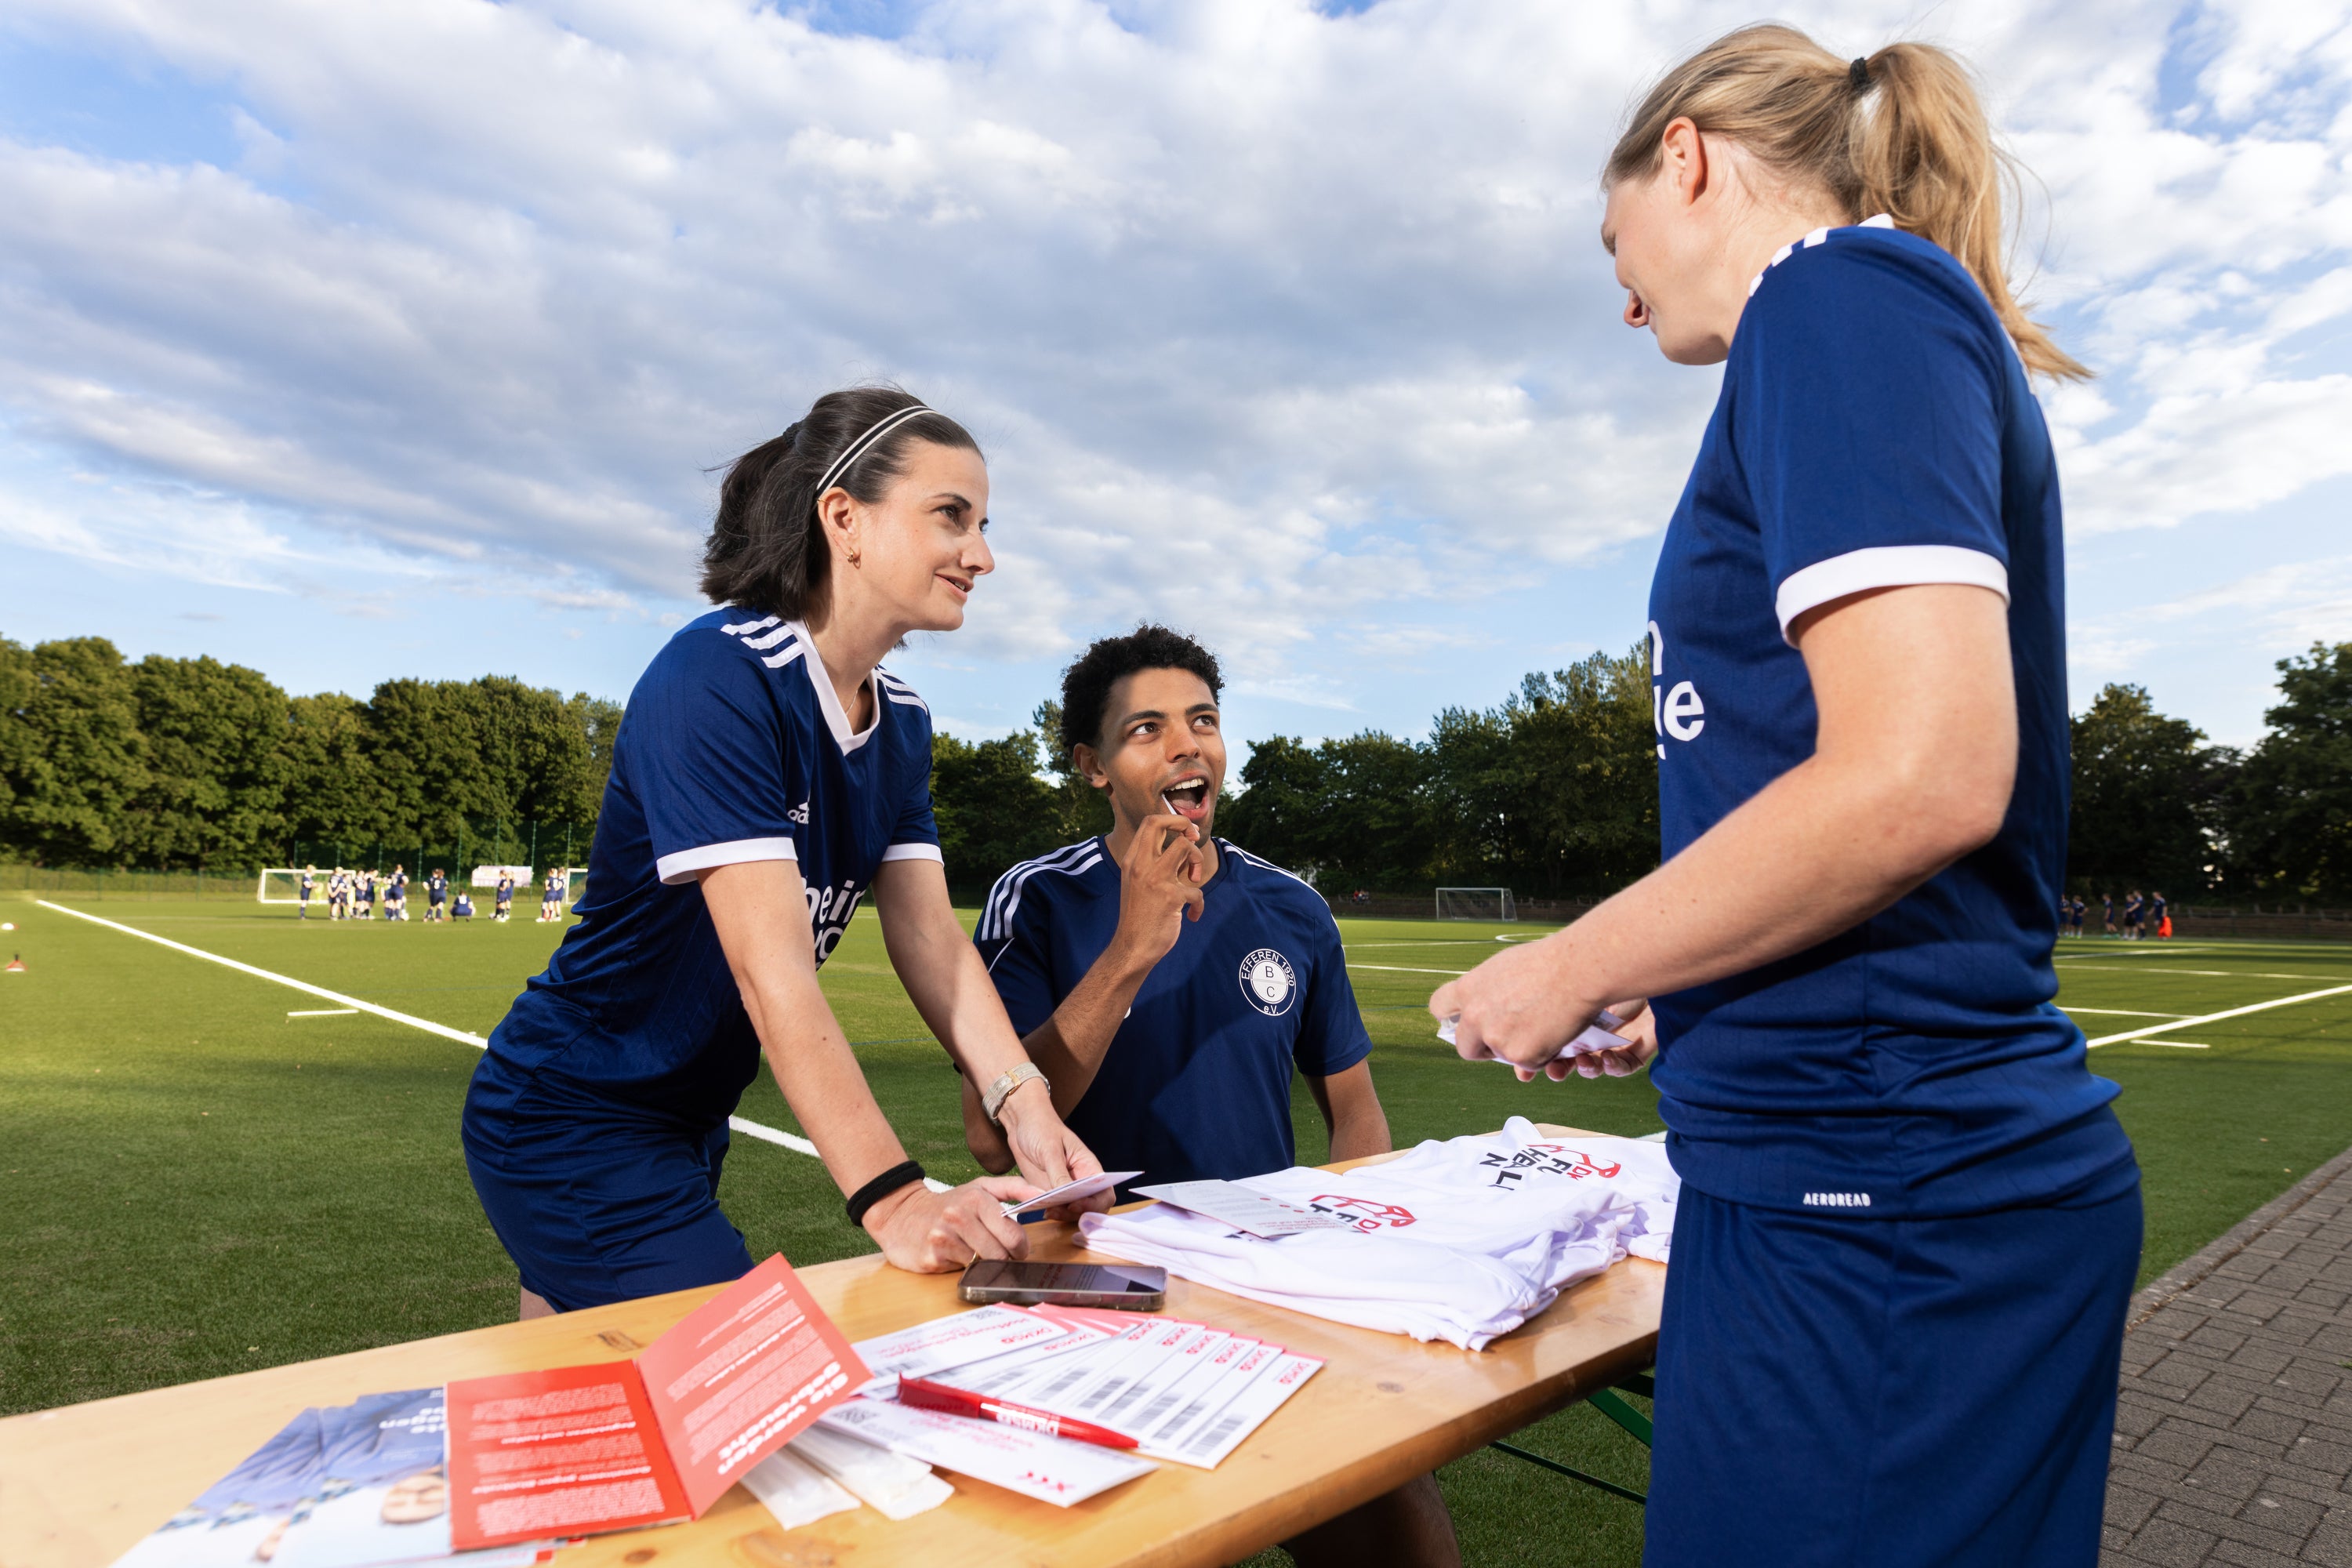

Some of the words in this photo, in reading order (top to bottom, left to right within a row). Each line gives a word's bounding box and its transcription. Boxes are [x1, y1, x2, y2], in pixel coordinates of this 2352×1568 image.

[1241, 950, 1279, 980] EFFEREN
[1281, 961, 1295, 987] 1920
[1265, 965, 1275, 978] B
[1266, 985, 1276, 998] C
[810, 1372, 849, 1404] Sie
[717, 1361, 841, 1461] gebraucht
[717, 1404, 808, 1475] werden
